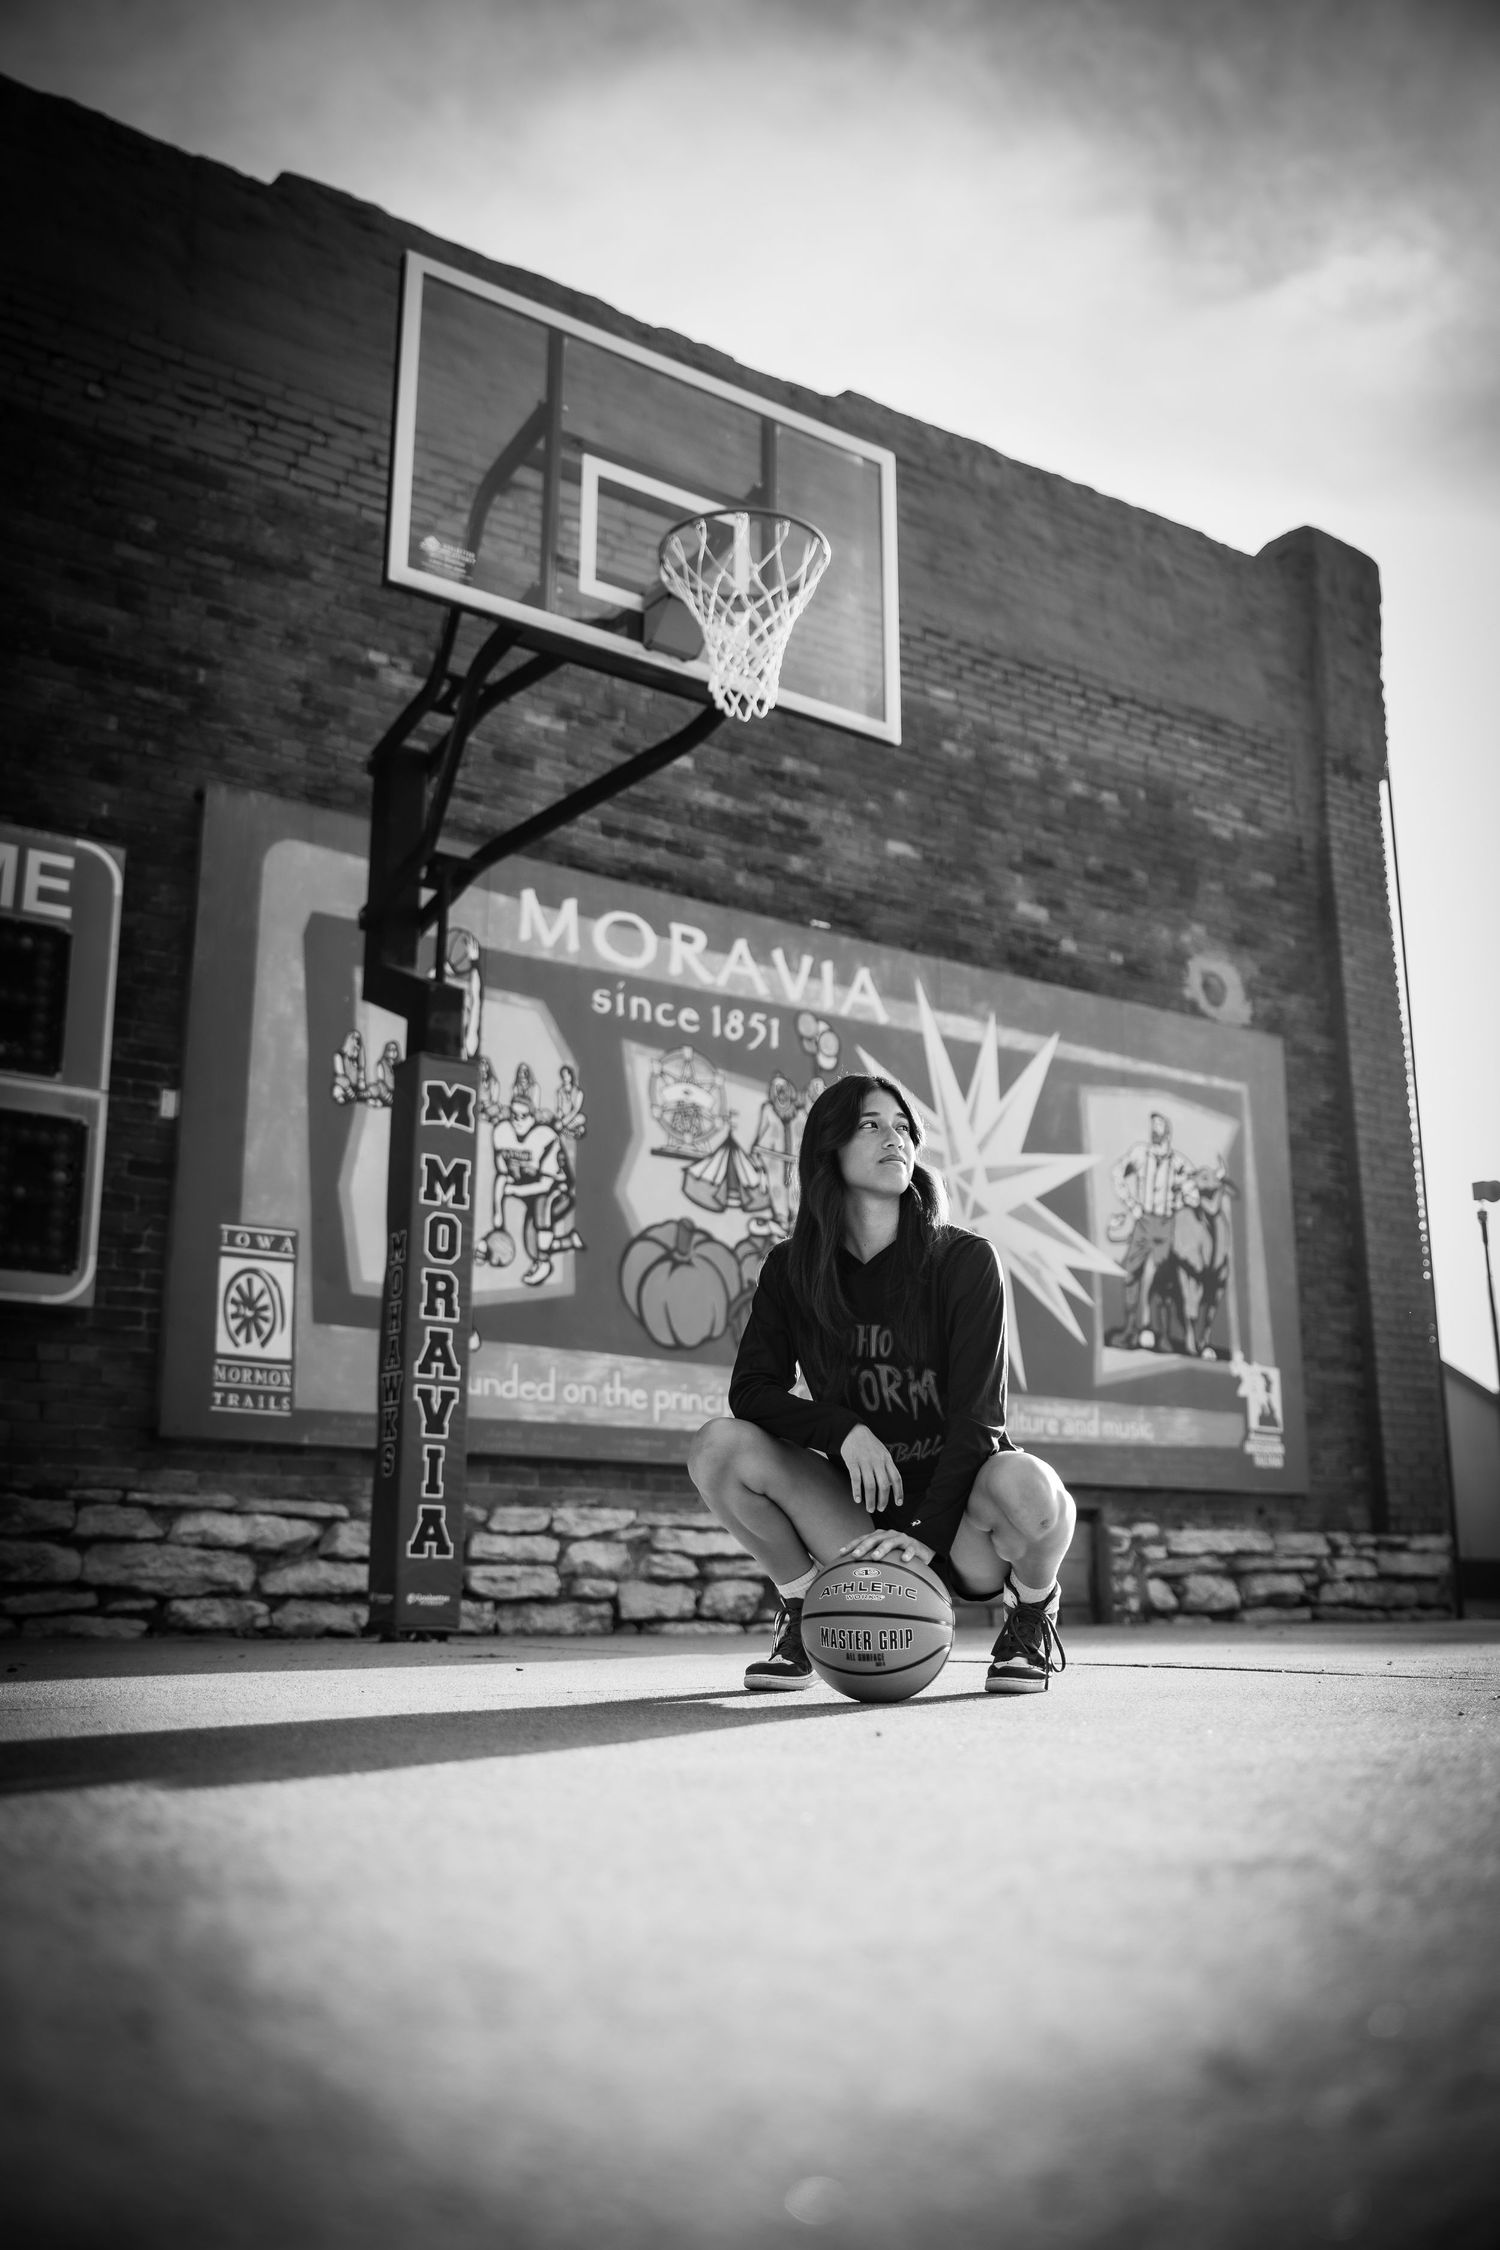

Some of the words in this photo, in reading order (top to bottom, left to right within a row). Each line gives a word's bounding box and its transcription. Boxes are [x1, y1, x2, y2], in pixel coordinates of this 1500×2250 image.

[519, 887, 889, 1025] MORAVIA
[591, 980, 701, 1033] since
[710, 1005, 780, 1051] 1851
[420, 1080, 477, 1133] M
[221, 1229, 294, 1253] IOWA
[380, 1229, 408, 1478] MOHAWKS
[406, 1152, 473, 1559] MORAVIA
[212, 1391, 292, 1411] TRAILS
[467, 1362, 556, 1401] unded
[562, 1382, 598, 1405] on
[604, 1371, 648, 1411] the
[1061, 1406, 1099, 1438] and
[819, 1581, 918, 1600] ATHLETIC
[820, 1626, 872, 1651] MASTER
[878, 1628, 913, 1650] GRIP
